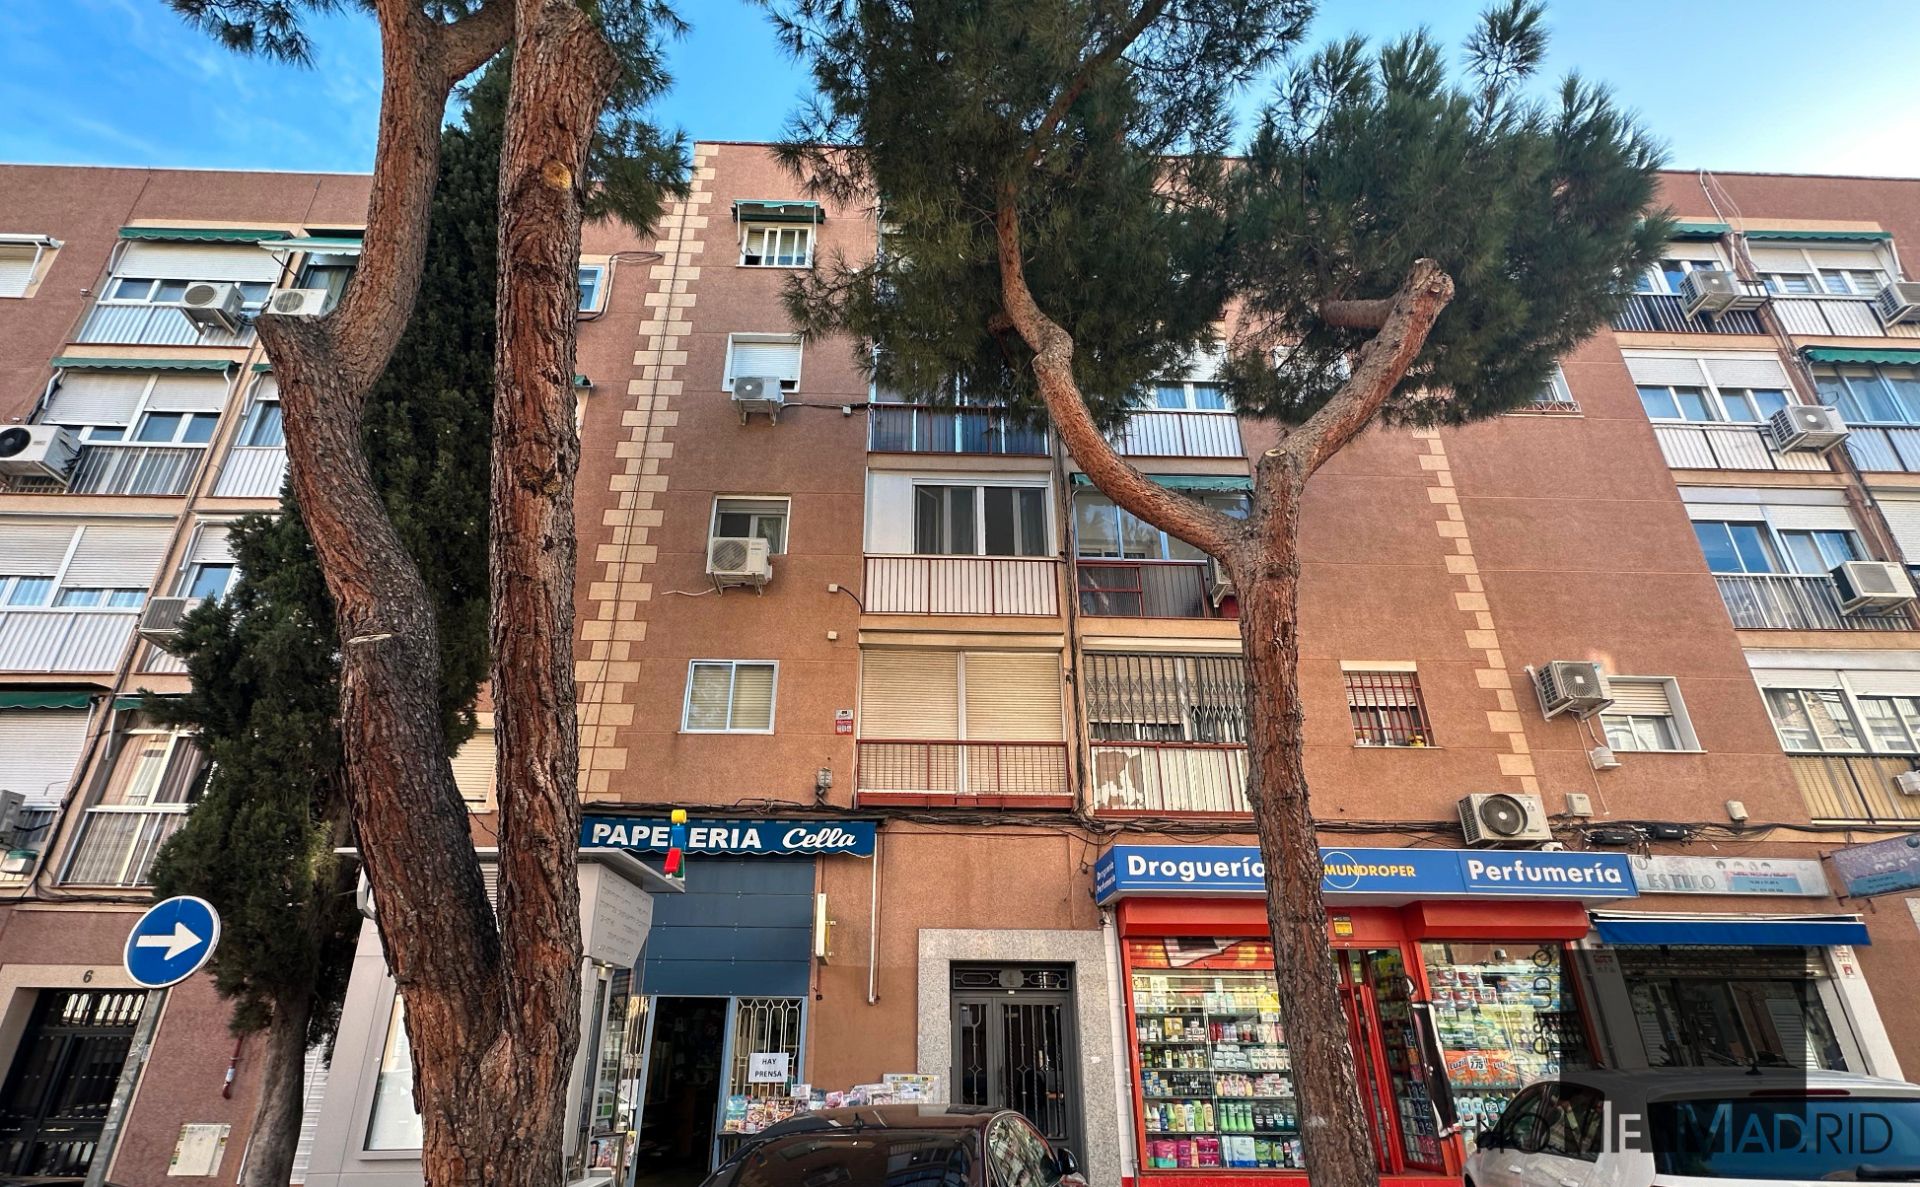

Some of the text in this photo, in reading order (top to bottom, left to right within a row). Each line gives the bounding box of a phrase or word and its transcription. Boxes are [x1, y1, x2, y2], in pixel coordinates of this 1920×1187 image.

[592, 824, 857, 849] PAPEERIA Cella
[1323, 864, 1417, 877] MUNDROPER
[1467, 860, 1622, 883] Perfumería
[83, 969, 94, 984] 6
[754, 1070, 783, 1078] PRENSA
